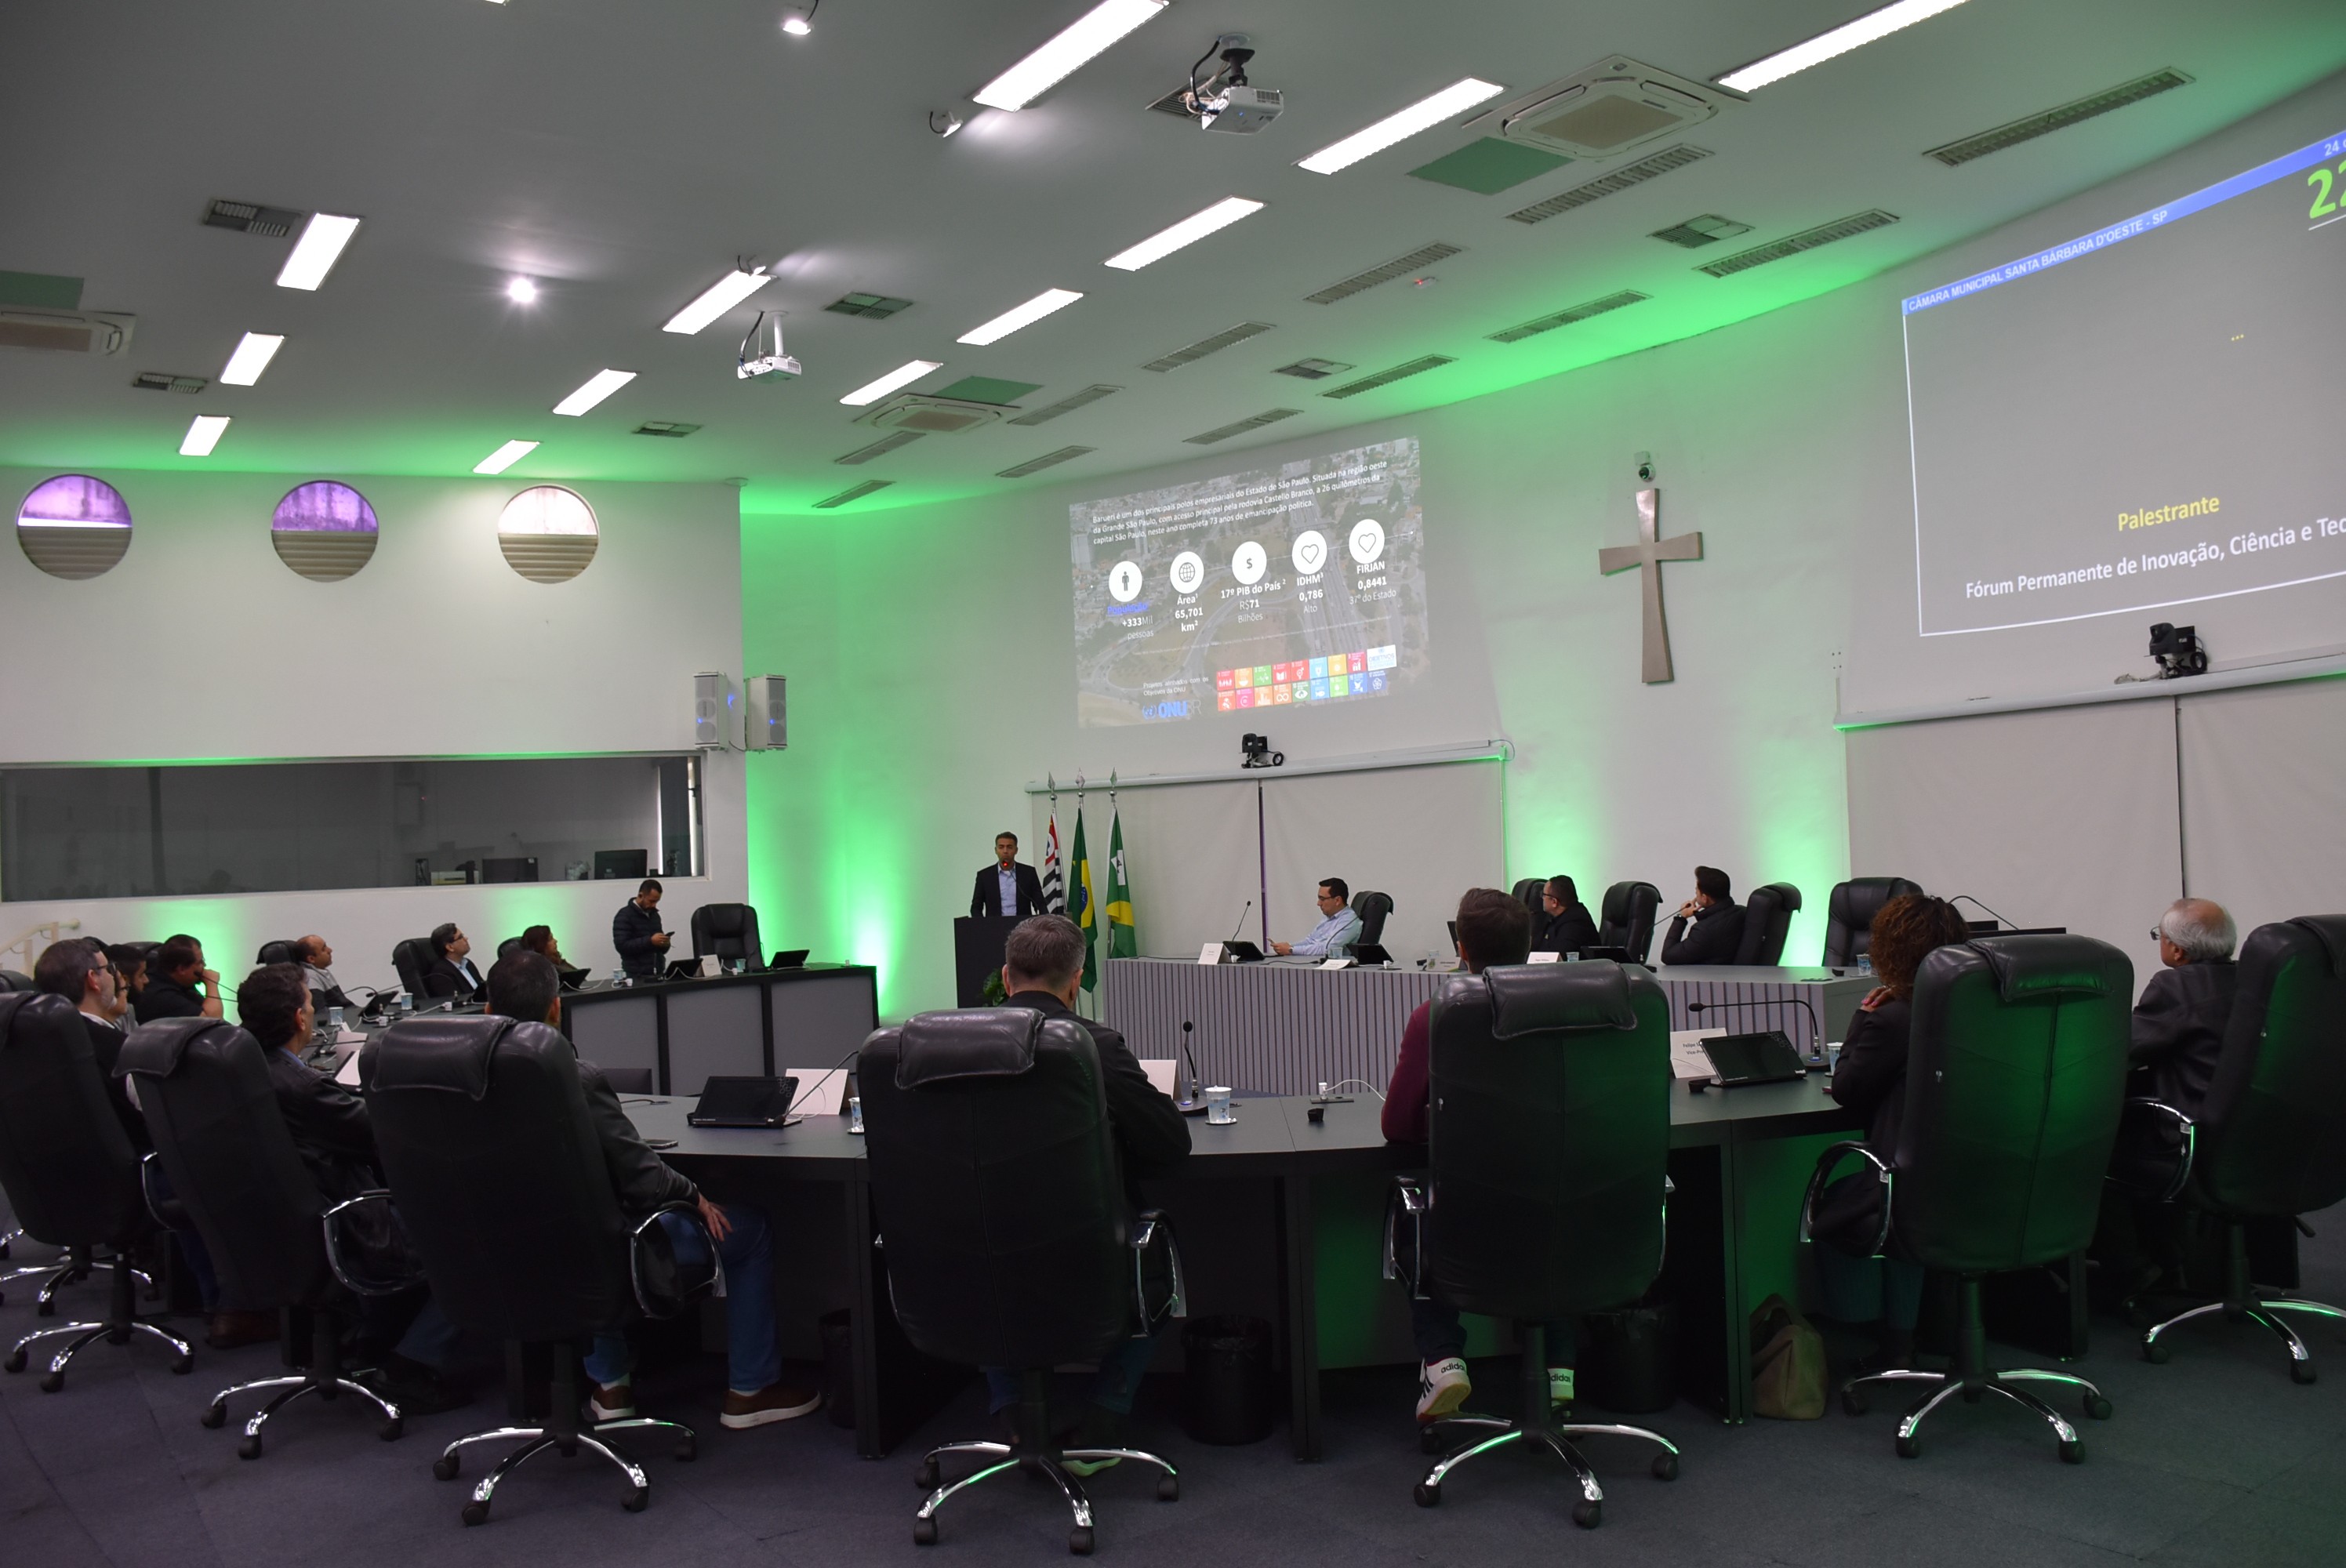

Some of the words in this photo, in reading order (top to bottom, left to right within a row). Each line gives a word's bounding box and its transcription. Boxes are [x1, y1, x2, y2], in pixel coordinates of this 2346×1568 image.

[2324, 140, 2340, 157] 24
[2308, 160, 2346, 219] 2
[1908, 289, 1950, 311] CÂMARA
[1951, 272, 2004, 297] MUNICIPAL
[2005, 259, 2039, 279] SANTA
[2041, 238, 2094, 267] BÁRBARA
[2096, 220, 2144, 246] D'OESTE
[2152, 210, 2168, 225] SP
[1092, 514, 1115, 524] Barueri
[1146, 503, 1175, 516] principais
[1176, 500, 1193, 510] polos
[1195, 491, 1235, 506] empresariais
[1236, 489, 1244, 498] do
[1245, 485, 1267, 496] Estado
[1268, 483, 1276, 492] de
[1278, 481, 1290, 490] São
[1312, 470, 1337, 483] Situada
[1347, 464, 1368, 476] região
[1369, 460, 1388, 470] oeste
[1102, 523, 1125, 533] Grande
[1126, 520, 1138, 529] São
[1138, 517, 1157, 528] Paulo,
[1158, 514, 1173, 524] com
[1173, 512, 1194, 521] acesso
[1195, 506, 1223, 517] principal
[1224, 503, 1237, 512] pela
[1239, 498, 1263, 509] rodovia
[1264, 492, 1290, 504] Castello
[1291, 488, 1315, 499] Branco,
[1331, 477, 1371, 491] quilômetros
[1371, 474, 1380, 482] da
[2118, 496, 2221, 532] Palestrante
[1093, 535, 1114, 546] capital
[1114, 532, 1127, 541] São
[1128, 530, 1147, 540] Paulo,
[1147, 527, 1165, 536] neste
[1178, 519, 1208, 531] completa
[1218, 515, 1234, 524] anos
[1244, 503, 1287, 519] emancipação
[1356, 561, 1385, 575] FIRJAN
[1966, 580, 2014, 598] Fórum
[2017, 563, 2112, 592] Permanente
[2116, 557, 2137, 576] de
[2141, 542, 2225, 572] Inovação,
[2229, 526, 2296, 555] Ciência
[2301, 525, 2312, 542] e
[1237, 586, 1251, 596] PIB
[1252, 584, 1263, 593] do
[1264, 581, 1281, 592] País
[1357, 576, 1387, 590] 0,8441
[1298, 590, 1324, 603] 0,786
[1362, 593, 1371, 603] do
[1373, 589, 1396, 601] Estado
[1239, 599, 1260, 610] R$71
[1303, 604, 1318, 614] Alto
[1175, 607, 1204, 619] 65,701
[1238, 613, 1263, 623] Bilhões
[1128, 630, 1154, 641] pessoas
[1143, 681, 1163, 689] Projetos
